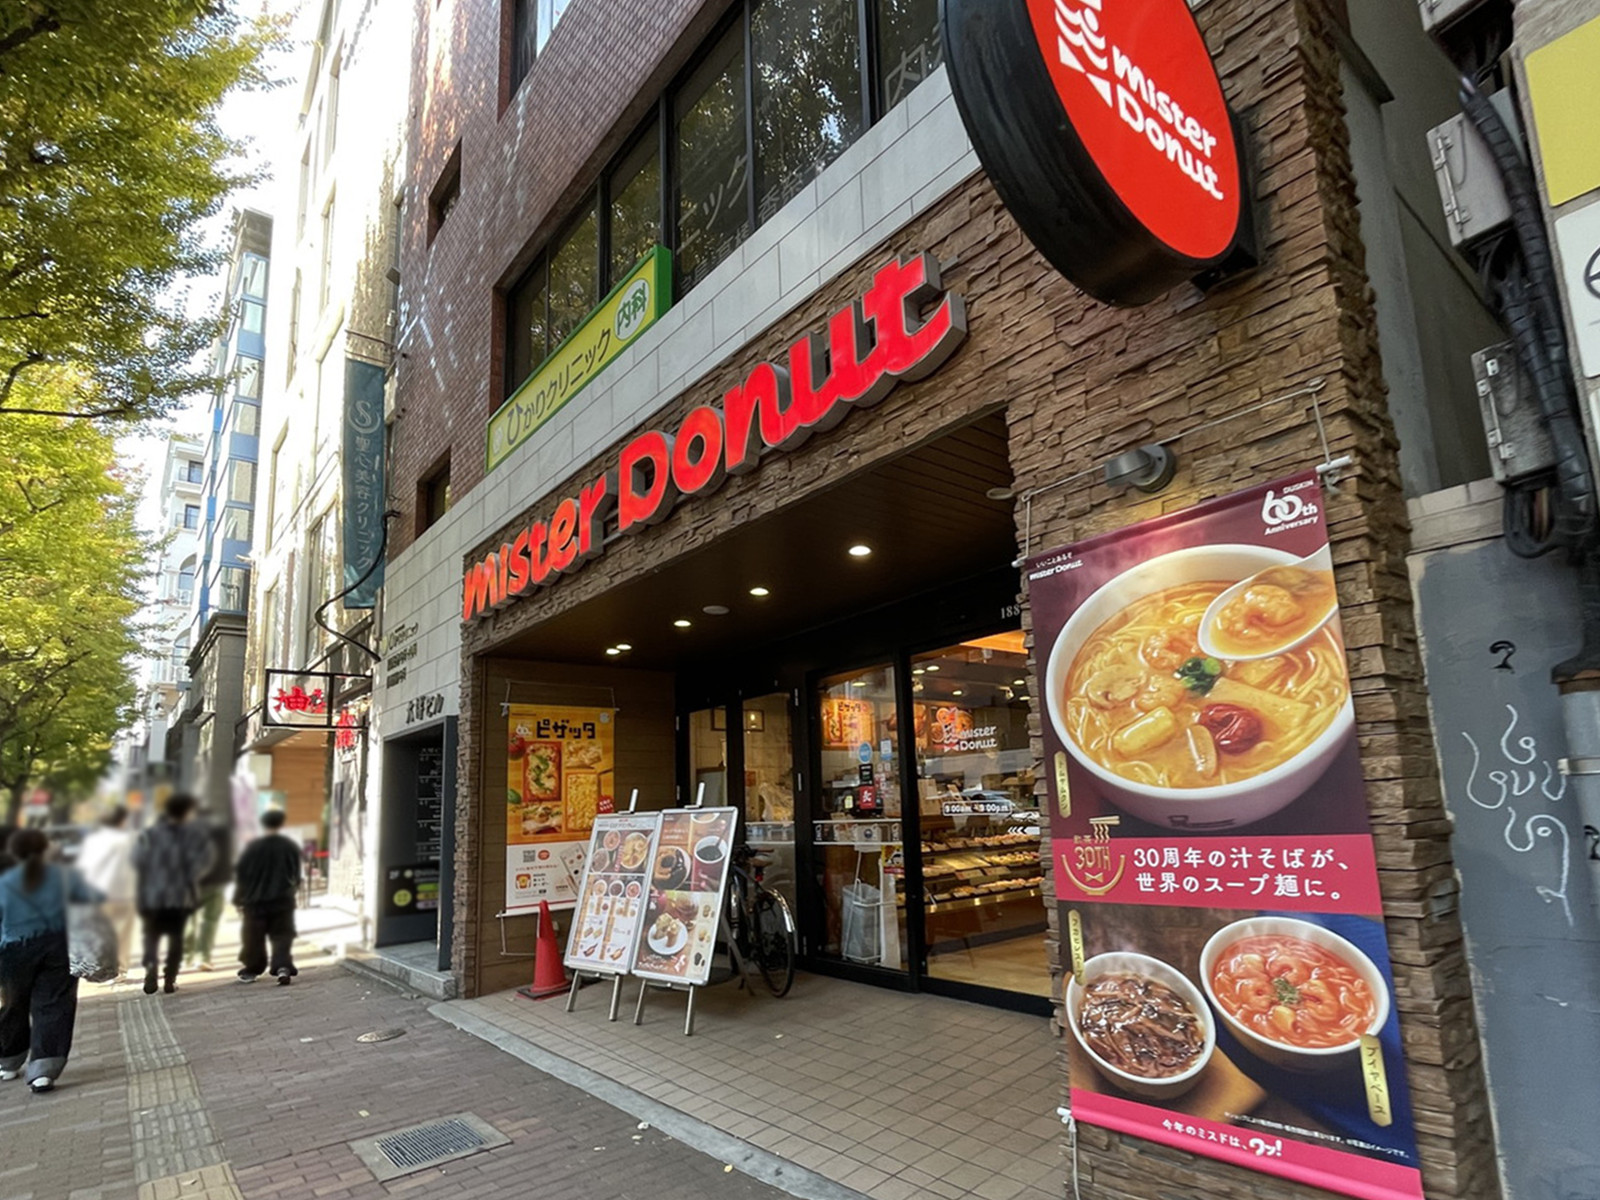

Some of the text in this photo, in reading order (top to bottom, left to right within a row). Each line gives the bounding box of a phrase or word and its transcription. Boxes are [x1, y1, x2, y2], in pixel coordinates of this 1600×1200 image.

[1116, 83, 1224, 201] Donut
[616, 282, 649, 336] 内科
[506, 327, 612, 446] ひかりクリニック
[618, 252, 958, 531] Donut
[1263, 516, 1319, 536] Anniversary
[536, 718, 596, 740] ピザッタ
[1074, 845, 1112, 871] 30TH
[1133, 846, 1349, 872] 30周年の汁そばが、
[1135, 872, 1341, 901] 世界のスープ麺に。
